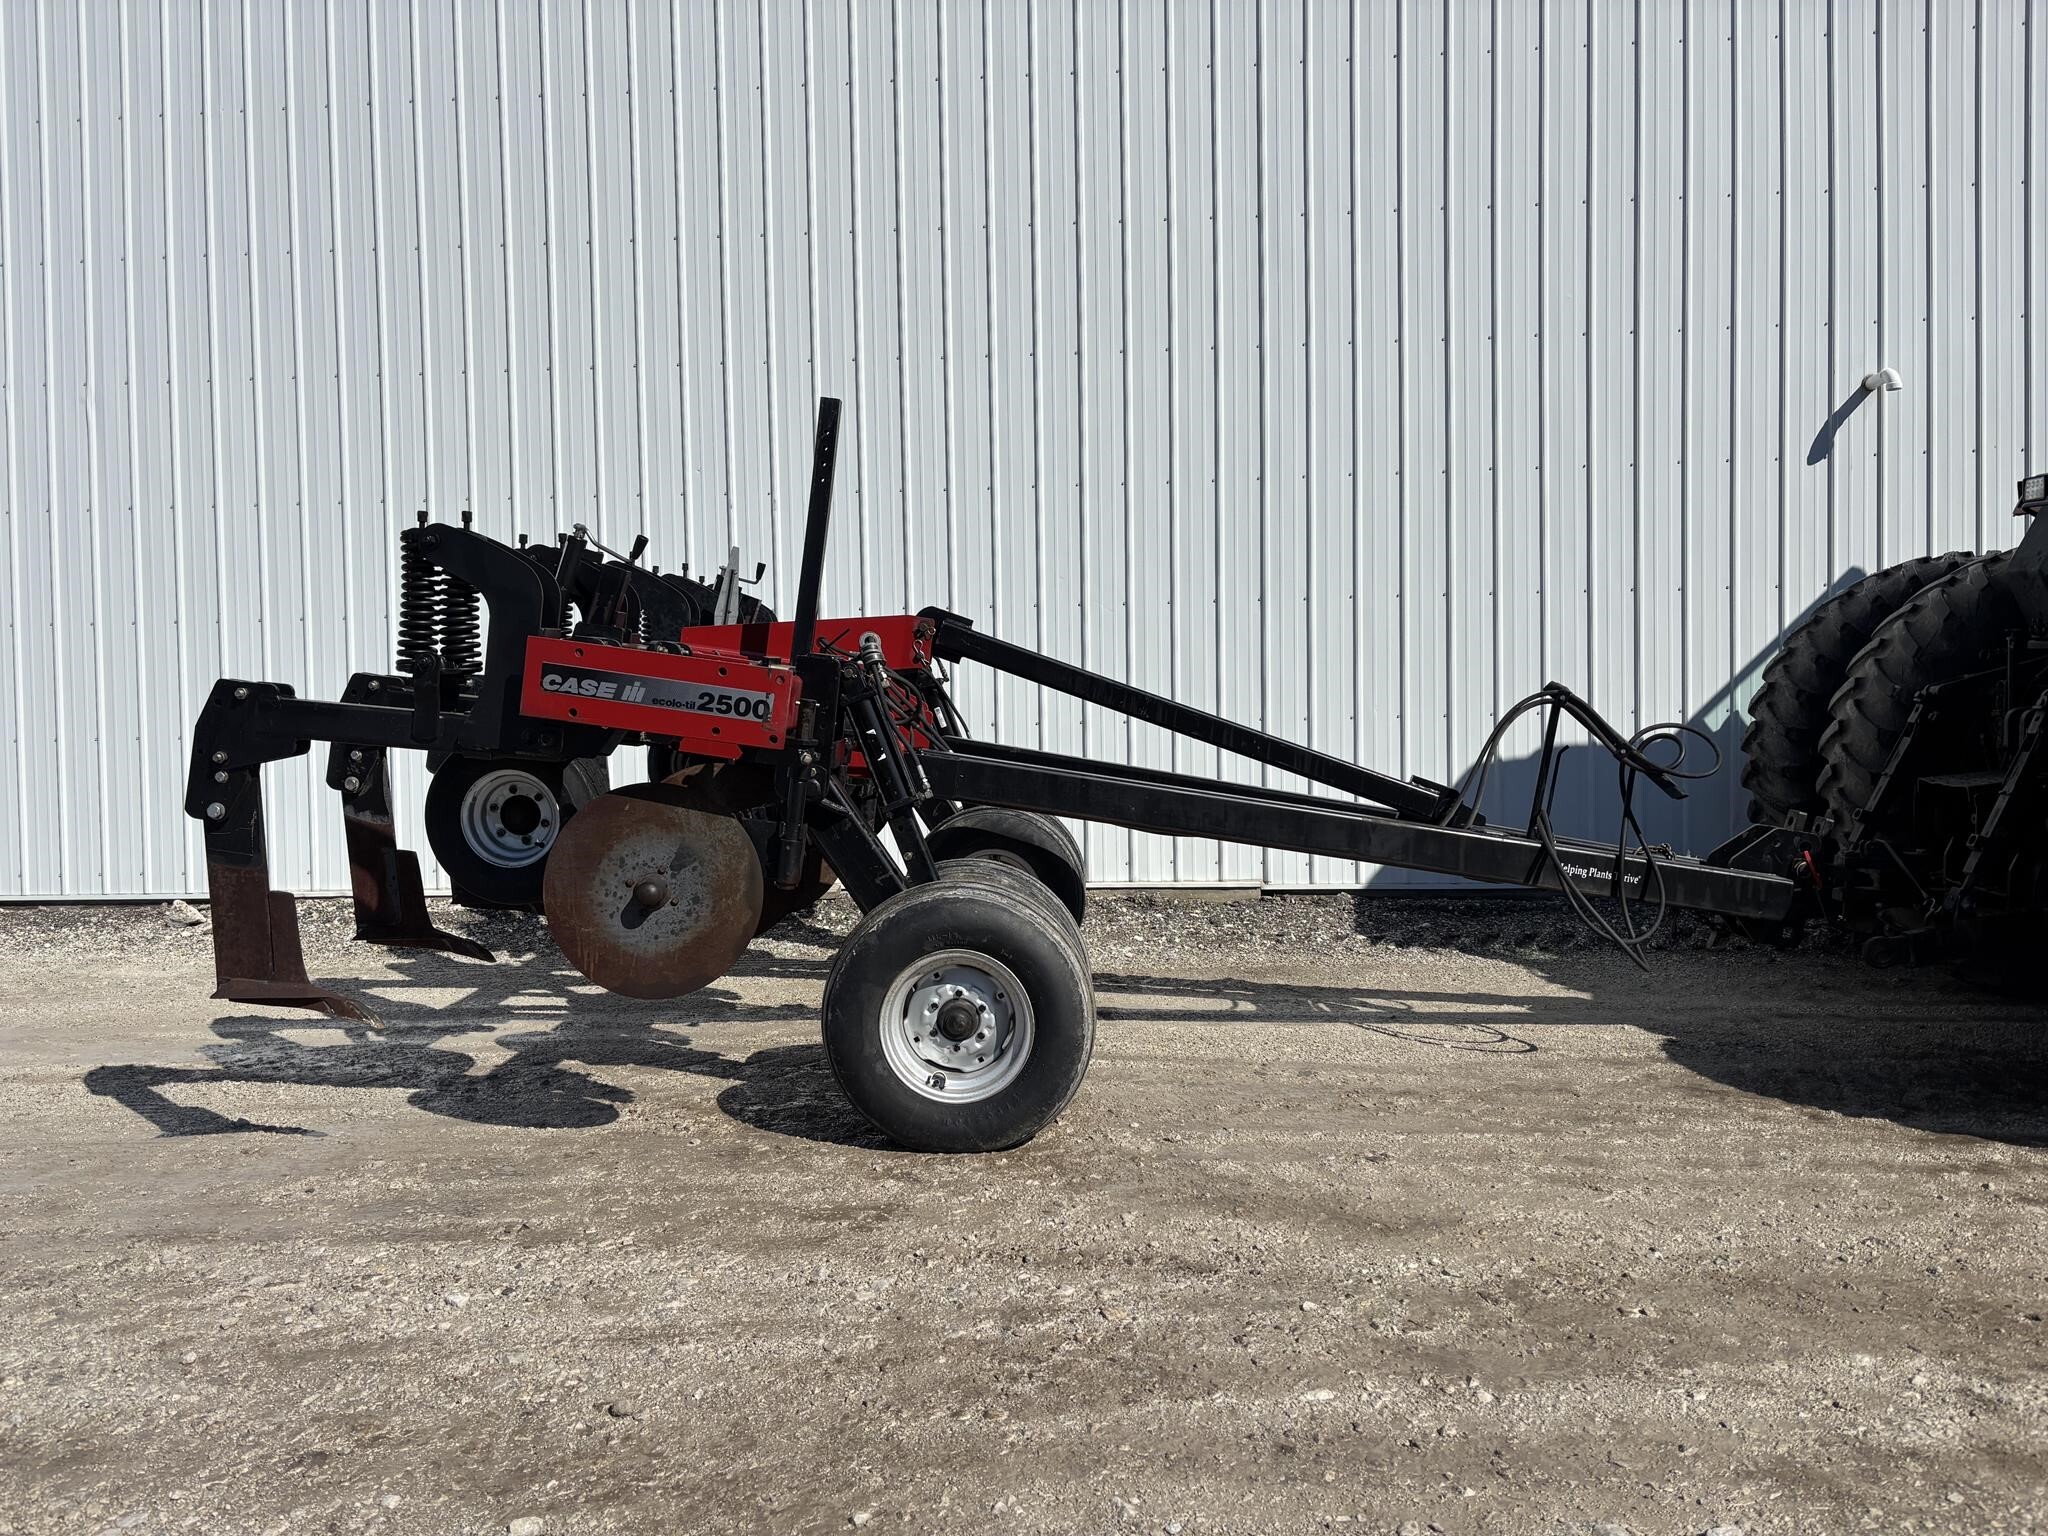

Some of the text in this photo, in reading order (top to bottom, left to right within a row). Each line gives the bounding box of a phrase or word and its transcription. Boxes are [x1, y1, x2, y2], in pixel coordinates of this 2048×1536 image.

[542, 673, 618, 699] CASE
[697, 692, 770, 720] 2500
[1560, 862, 1588, 879] elping
[1588, 867, 1612, 880] Plants
